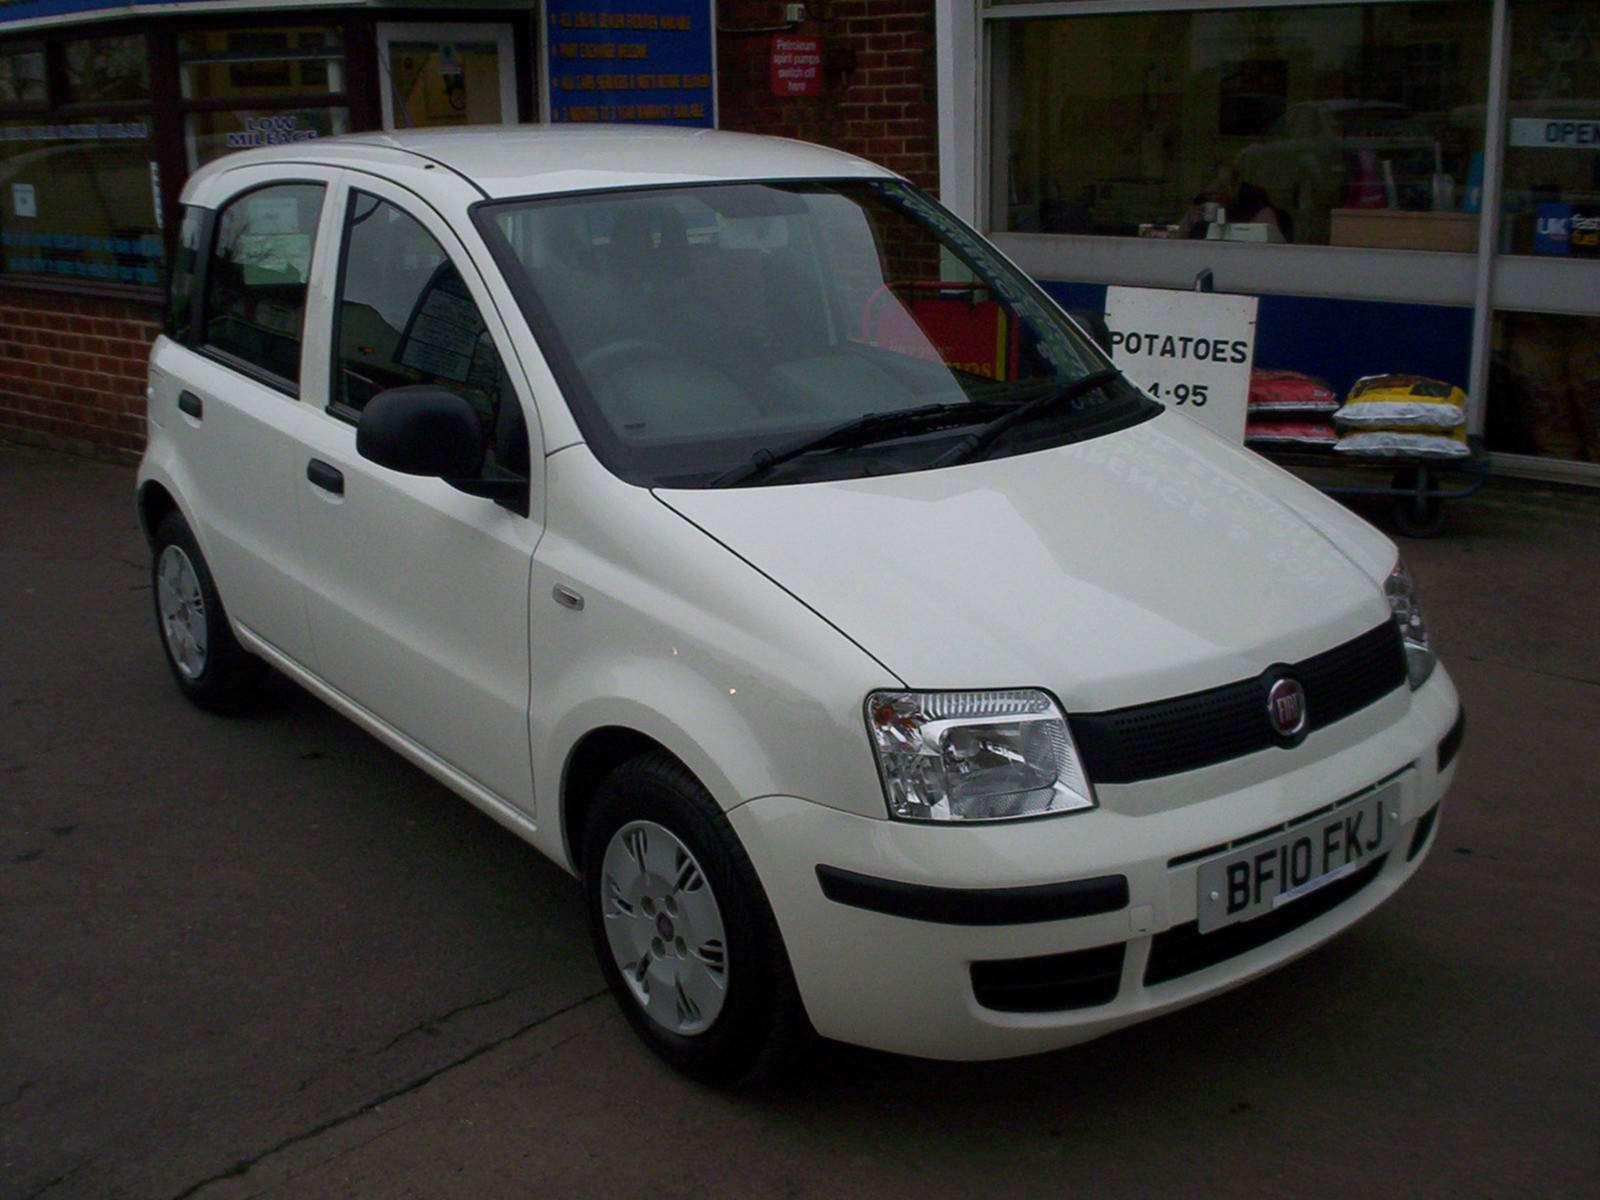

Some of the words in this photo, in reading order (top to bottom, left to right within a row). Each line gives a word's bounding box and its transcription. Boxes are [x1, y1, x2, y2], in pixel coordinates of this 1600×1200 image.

[245, 115, 297, 132] LOW
[1110, 331, 1248, 364] POTATOES
[1226, 836, 1312, 915] BF10
[1322, 801, 1383, 874] FKJ
